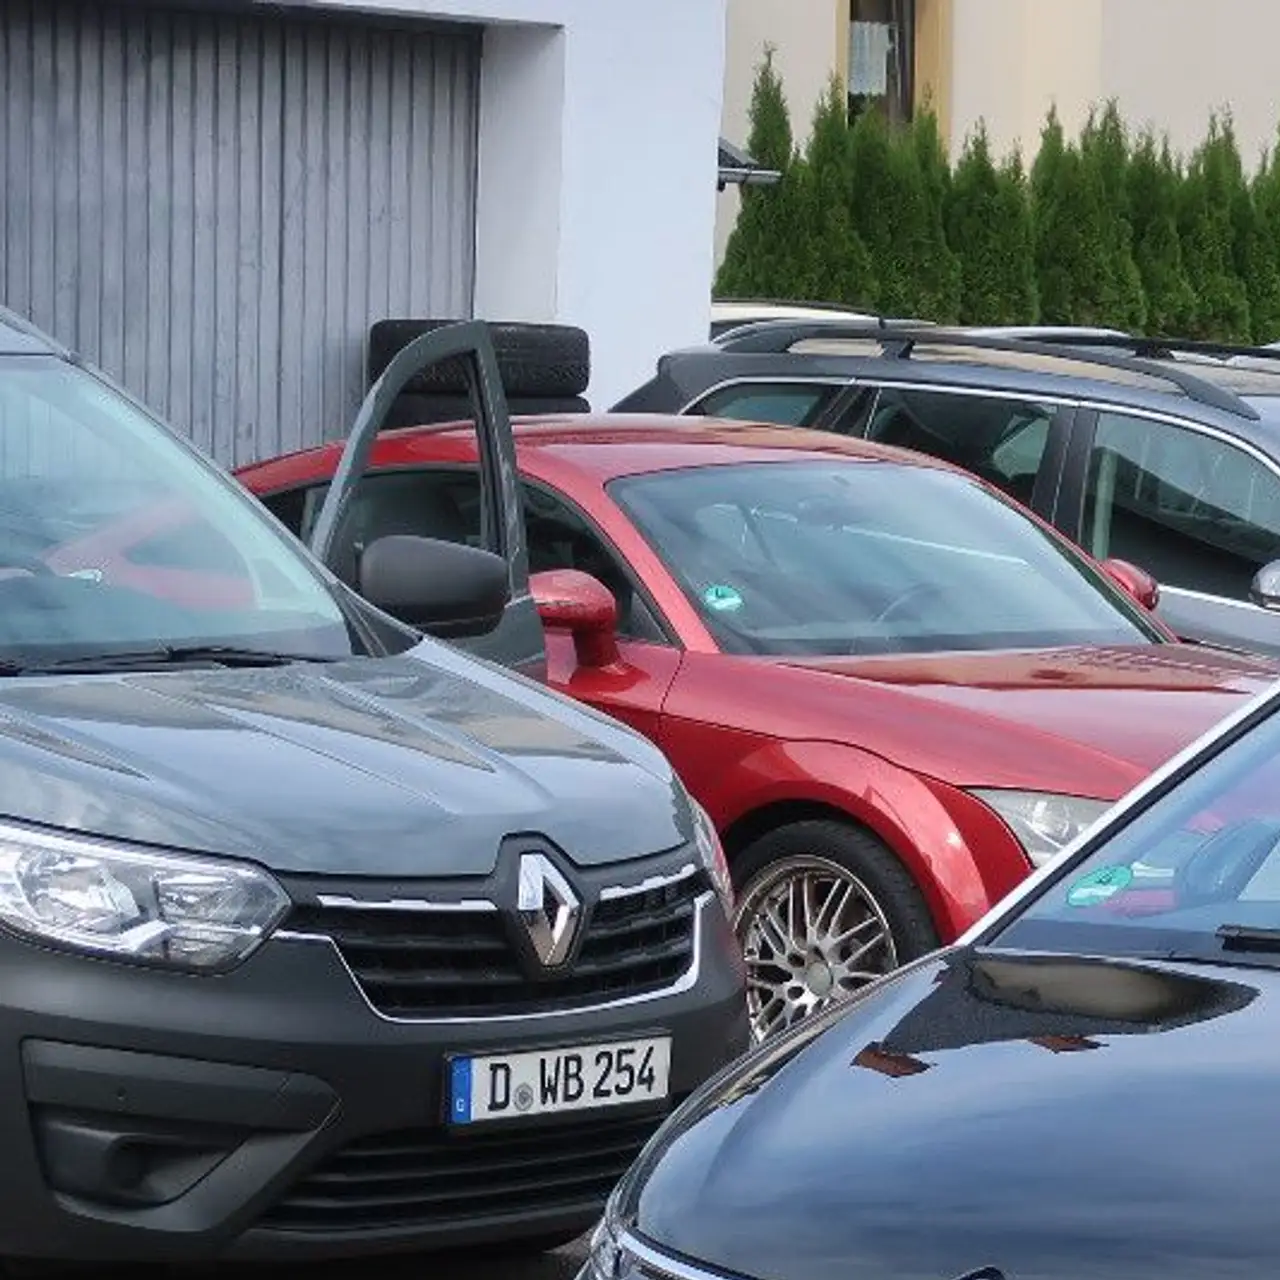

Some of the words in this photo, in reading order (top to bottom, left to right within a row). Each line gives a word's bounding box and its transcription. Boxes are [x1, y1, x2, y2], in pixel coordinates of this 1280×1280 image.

[487, 1063, 511, 1112] D
[539, 1053, 585, 1105] WB
[592, 1045, 656, 1098] 254
